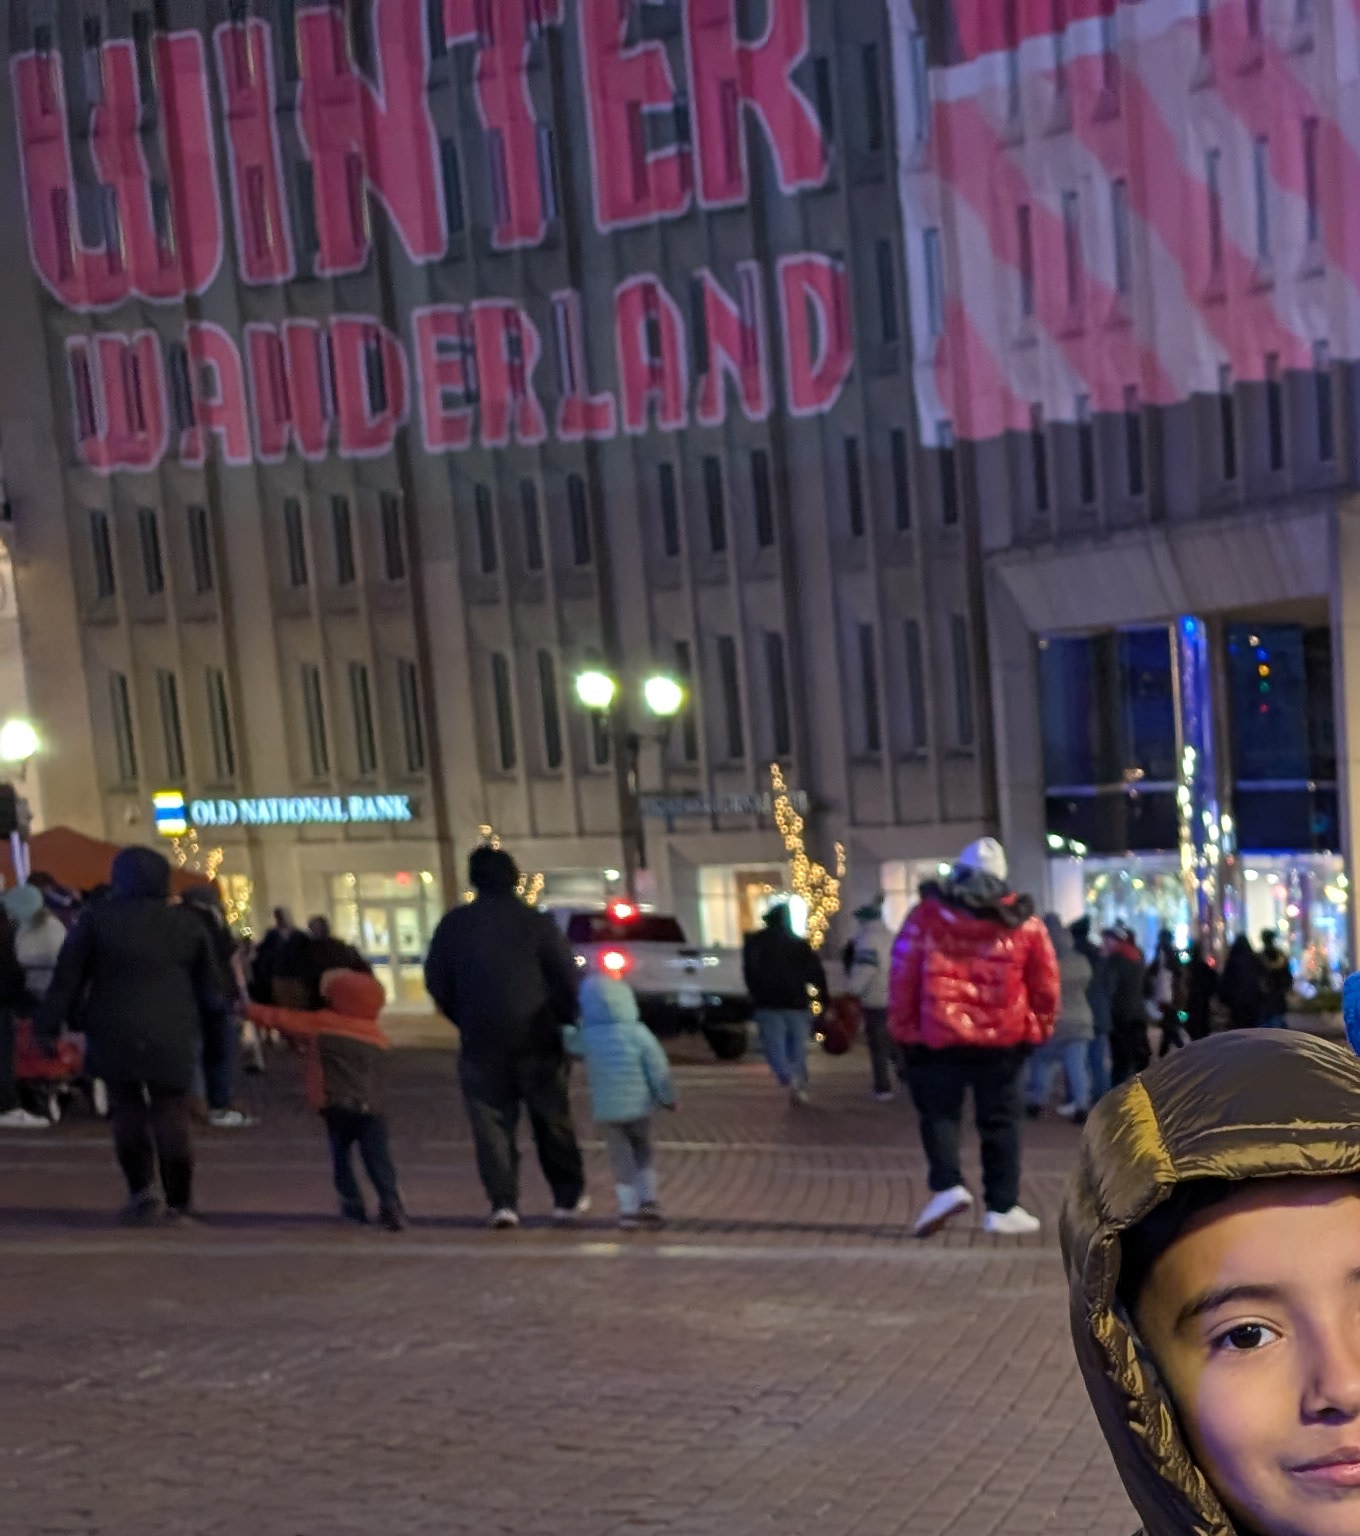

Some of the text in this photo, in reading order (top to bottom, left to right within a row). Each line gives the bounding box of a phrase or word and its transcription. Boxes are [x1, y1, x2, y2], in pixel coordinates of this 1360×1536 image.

[10, 0, 832, 312] WINTER
[66, 253, 854, 475] WANDERLAND
[190, 794, 413, 827] OLD NATIONAL BANK
